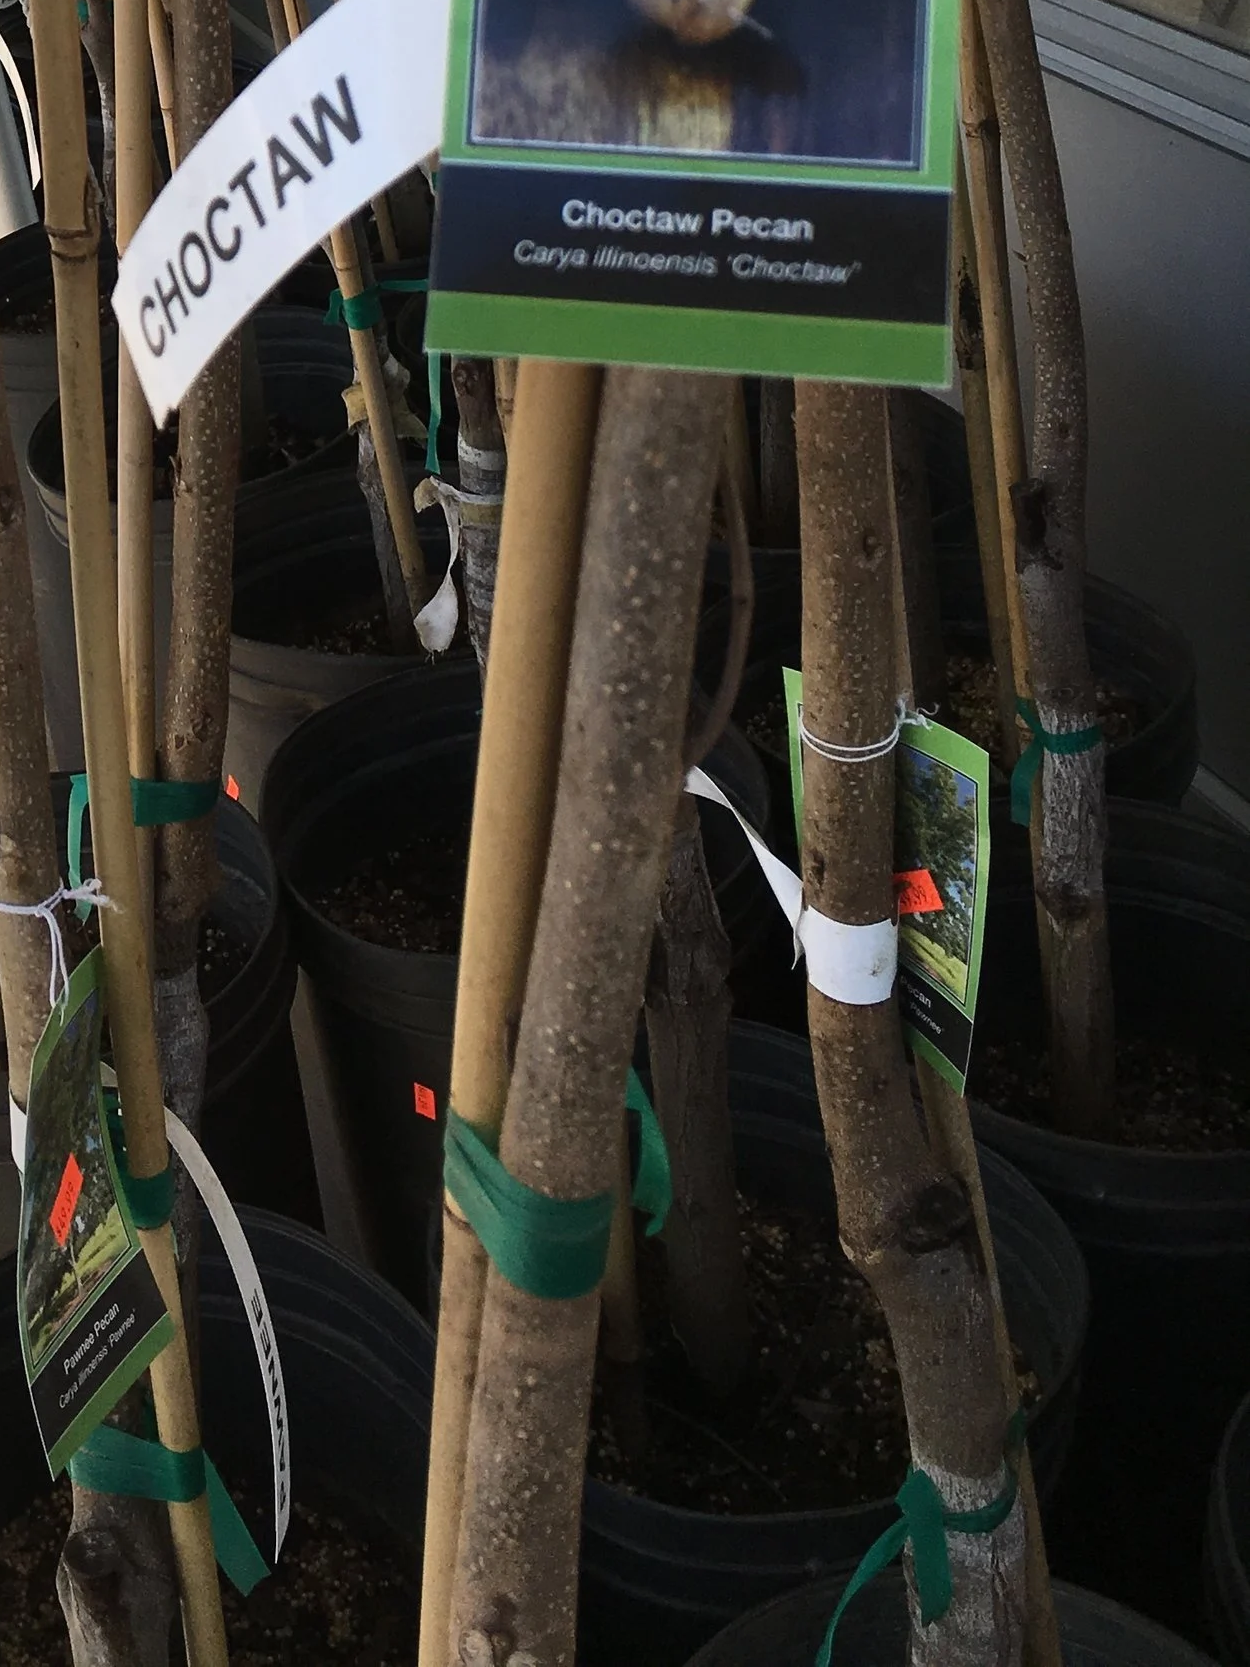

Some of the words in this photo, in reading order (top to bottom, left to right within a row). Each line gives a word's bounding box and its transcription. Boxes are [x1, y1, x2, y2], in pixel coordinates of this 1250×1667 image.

[140, 72, 362, 358] CHOCTAW
[561, 198, 703, 235] Choctaw
[710, 208, 815, 242] Pecan
[513, 238, 586, 274] Carya
[593, 244, 719, 277] illinoensis
[63, 1333, 95, 1375] Pawnee
[93, 1303, 120, 1337] Pecan
[59, 1381, 79, 1409] Carya
